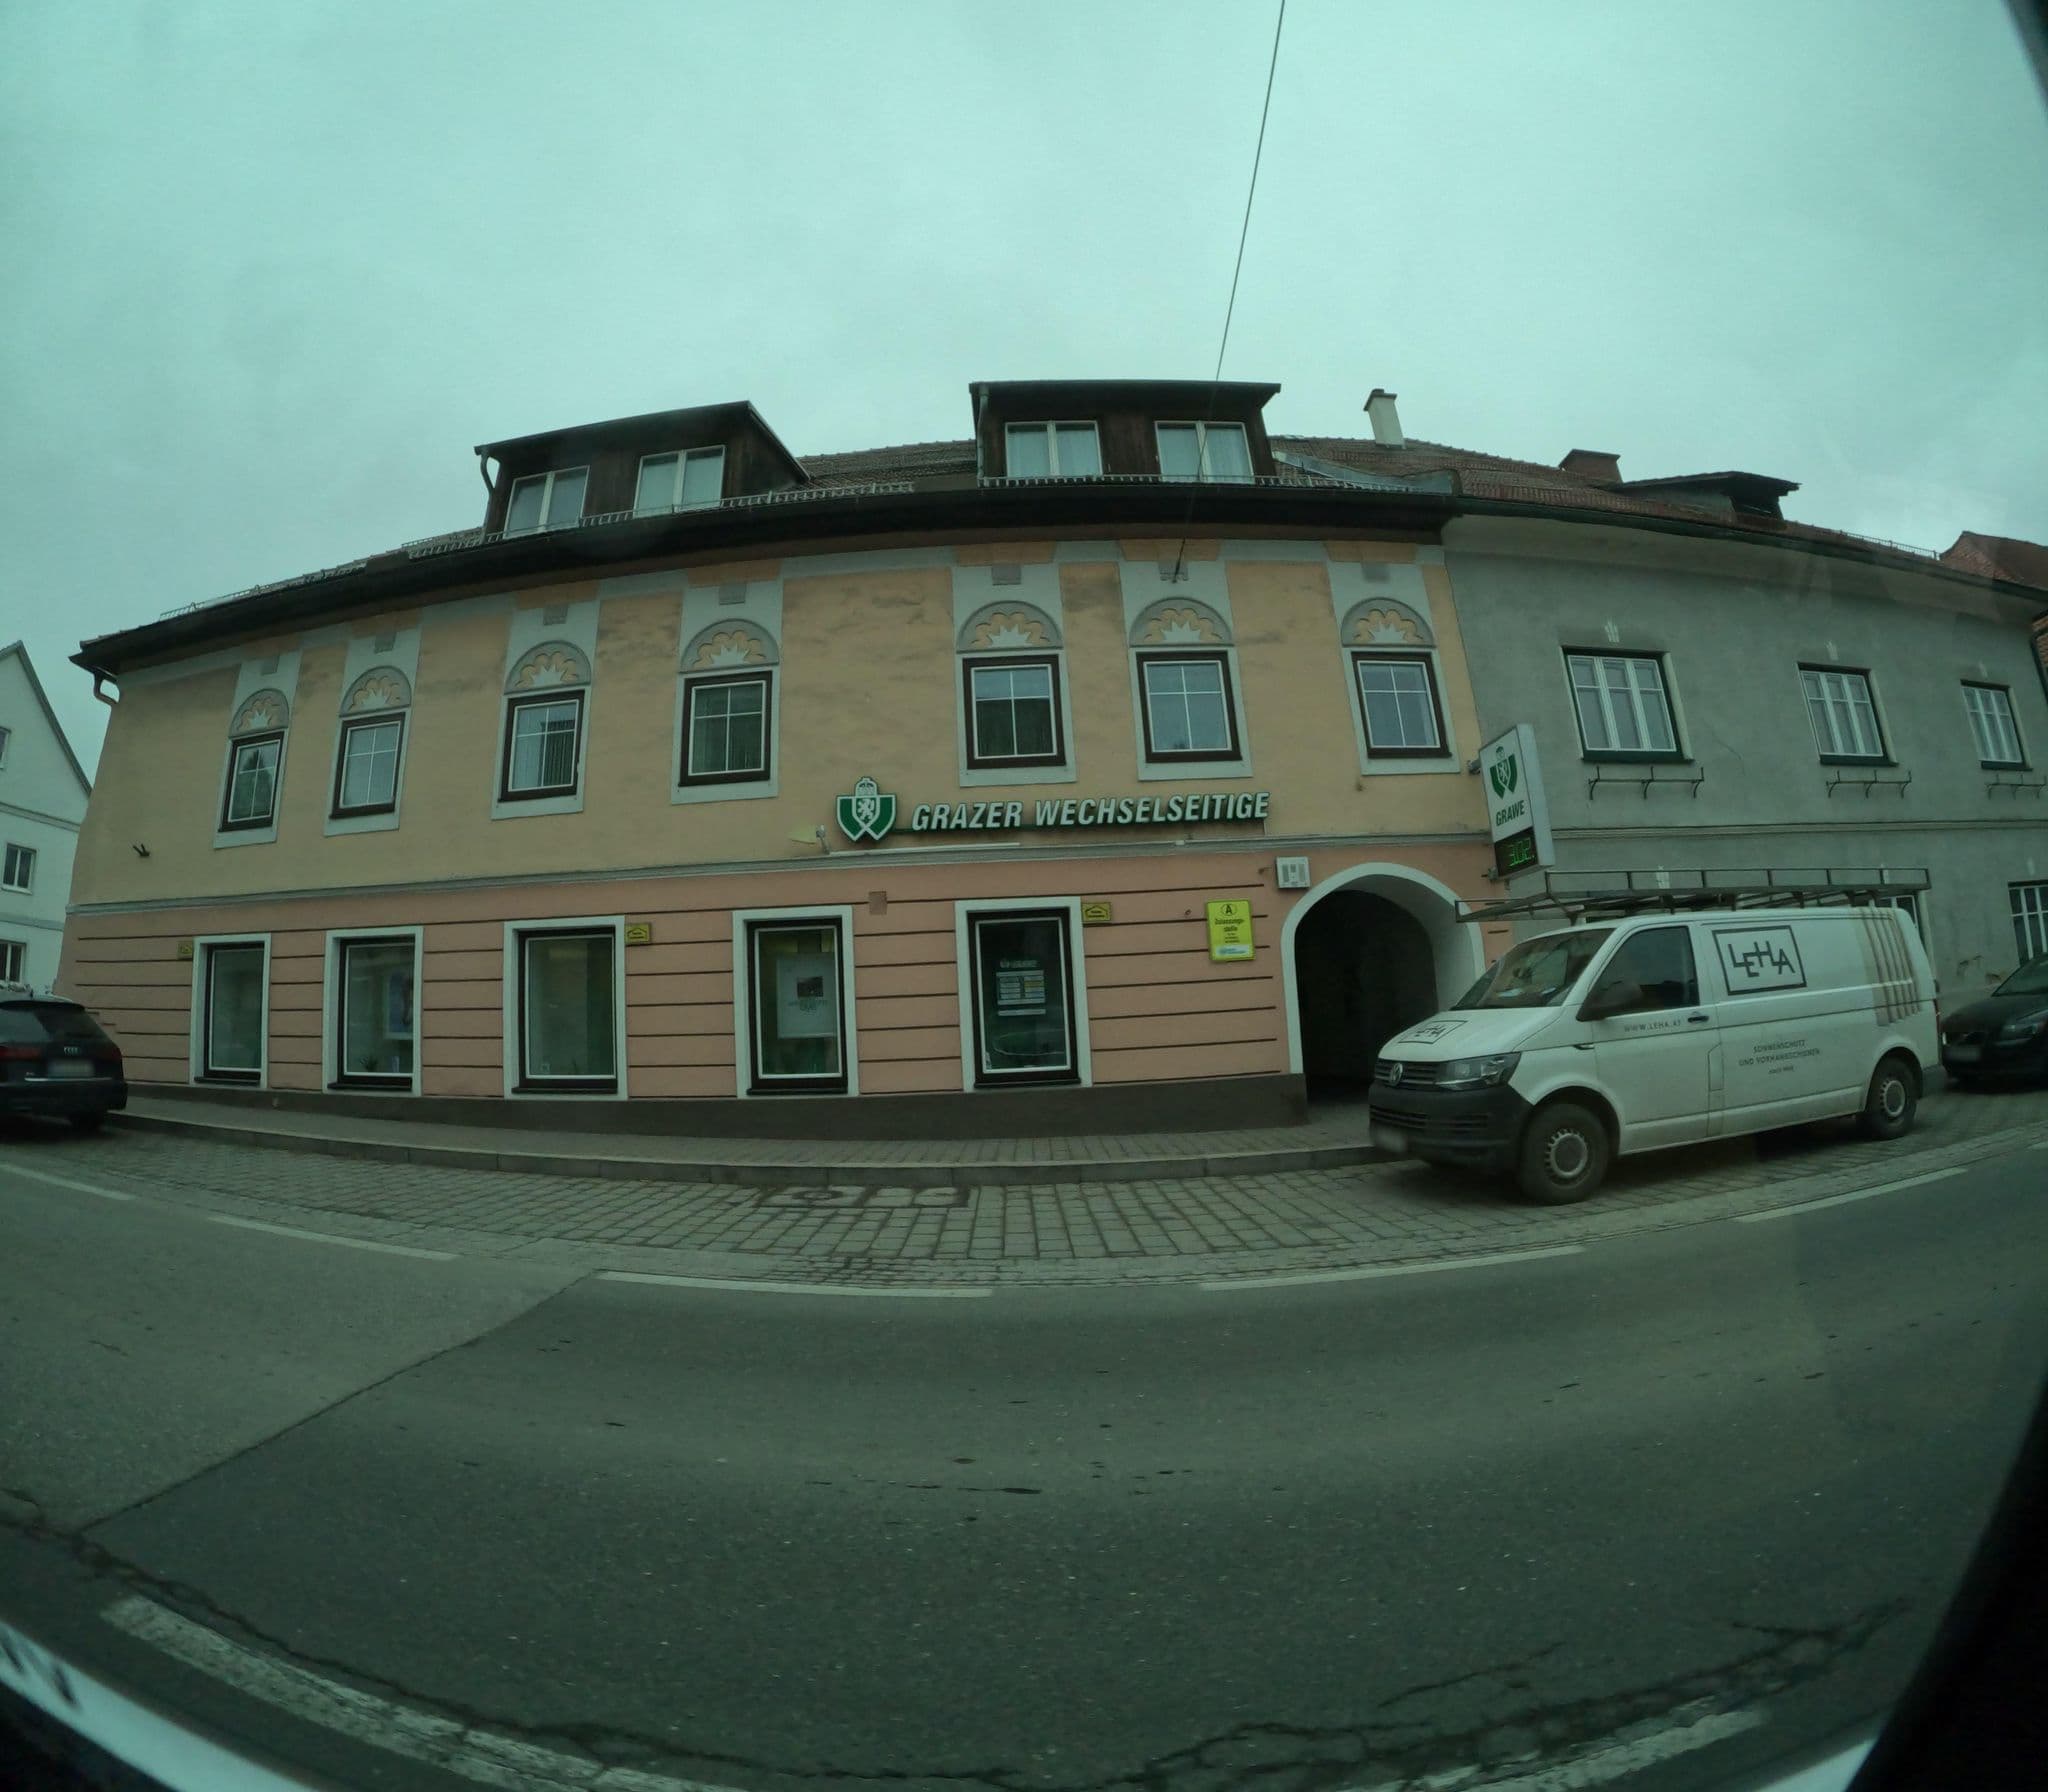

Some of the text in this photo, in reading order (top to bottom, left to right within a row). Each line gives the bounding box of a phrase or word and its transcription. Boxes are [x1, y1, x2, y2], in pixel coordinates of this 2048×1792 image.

[911, 792, 1271, 831] GRAZER WECHSELSEITIGE
[1495, 800, 1526, 827] GRAWE
[1727, 940, 1796, 977] LEHA
